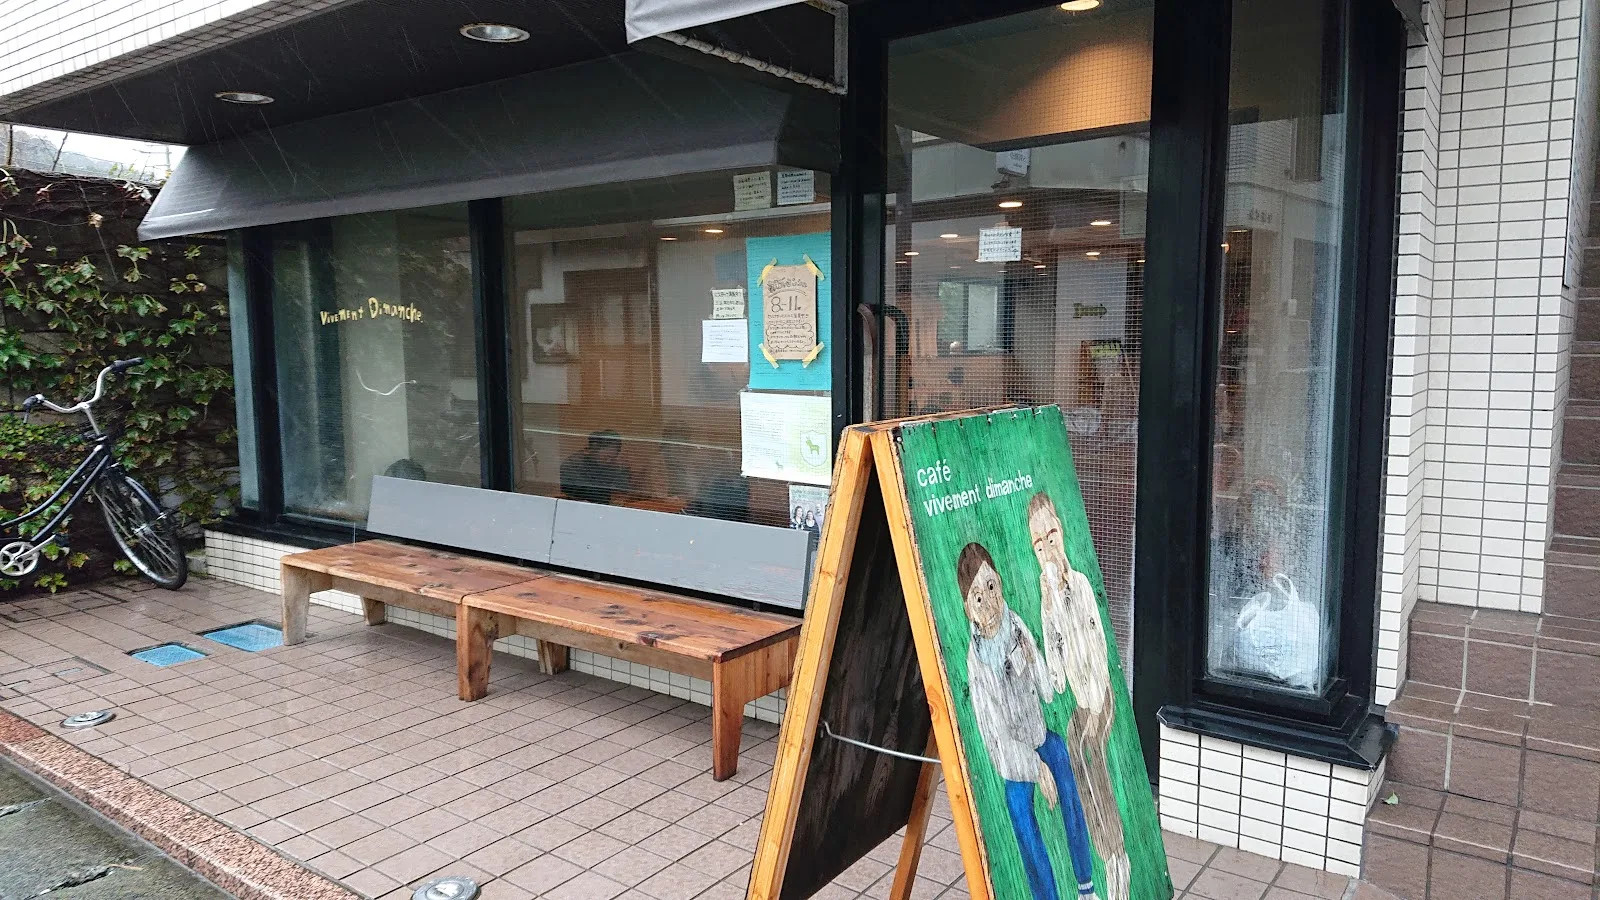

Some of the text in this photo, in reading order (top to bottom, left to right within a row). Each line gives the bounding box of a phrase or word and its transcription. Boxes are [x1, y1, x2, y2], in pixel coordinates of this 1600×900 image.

[917, 459, 952, 487] café
[923, 470, 1033, 517] vivement dimanche
